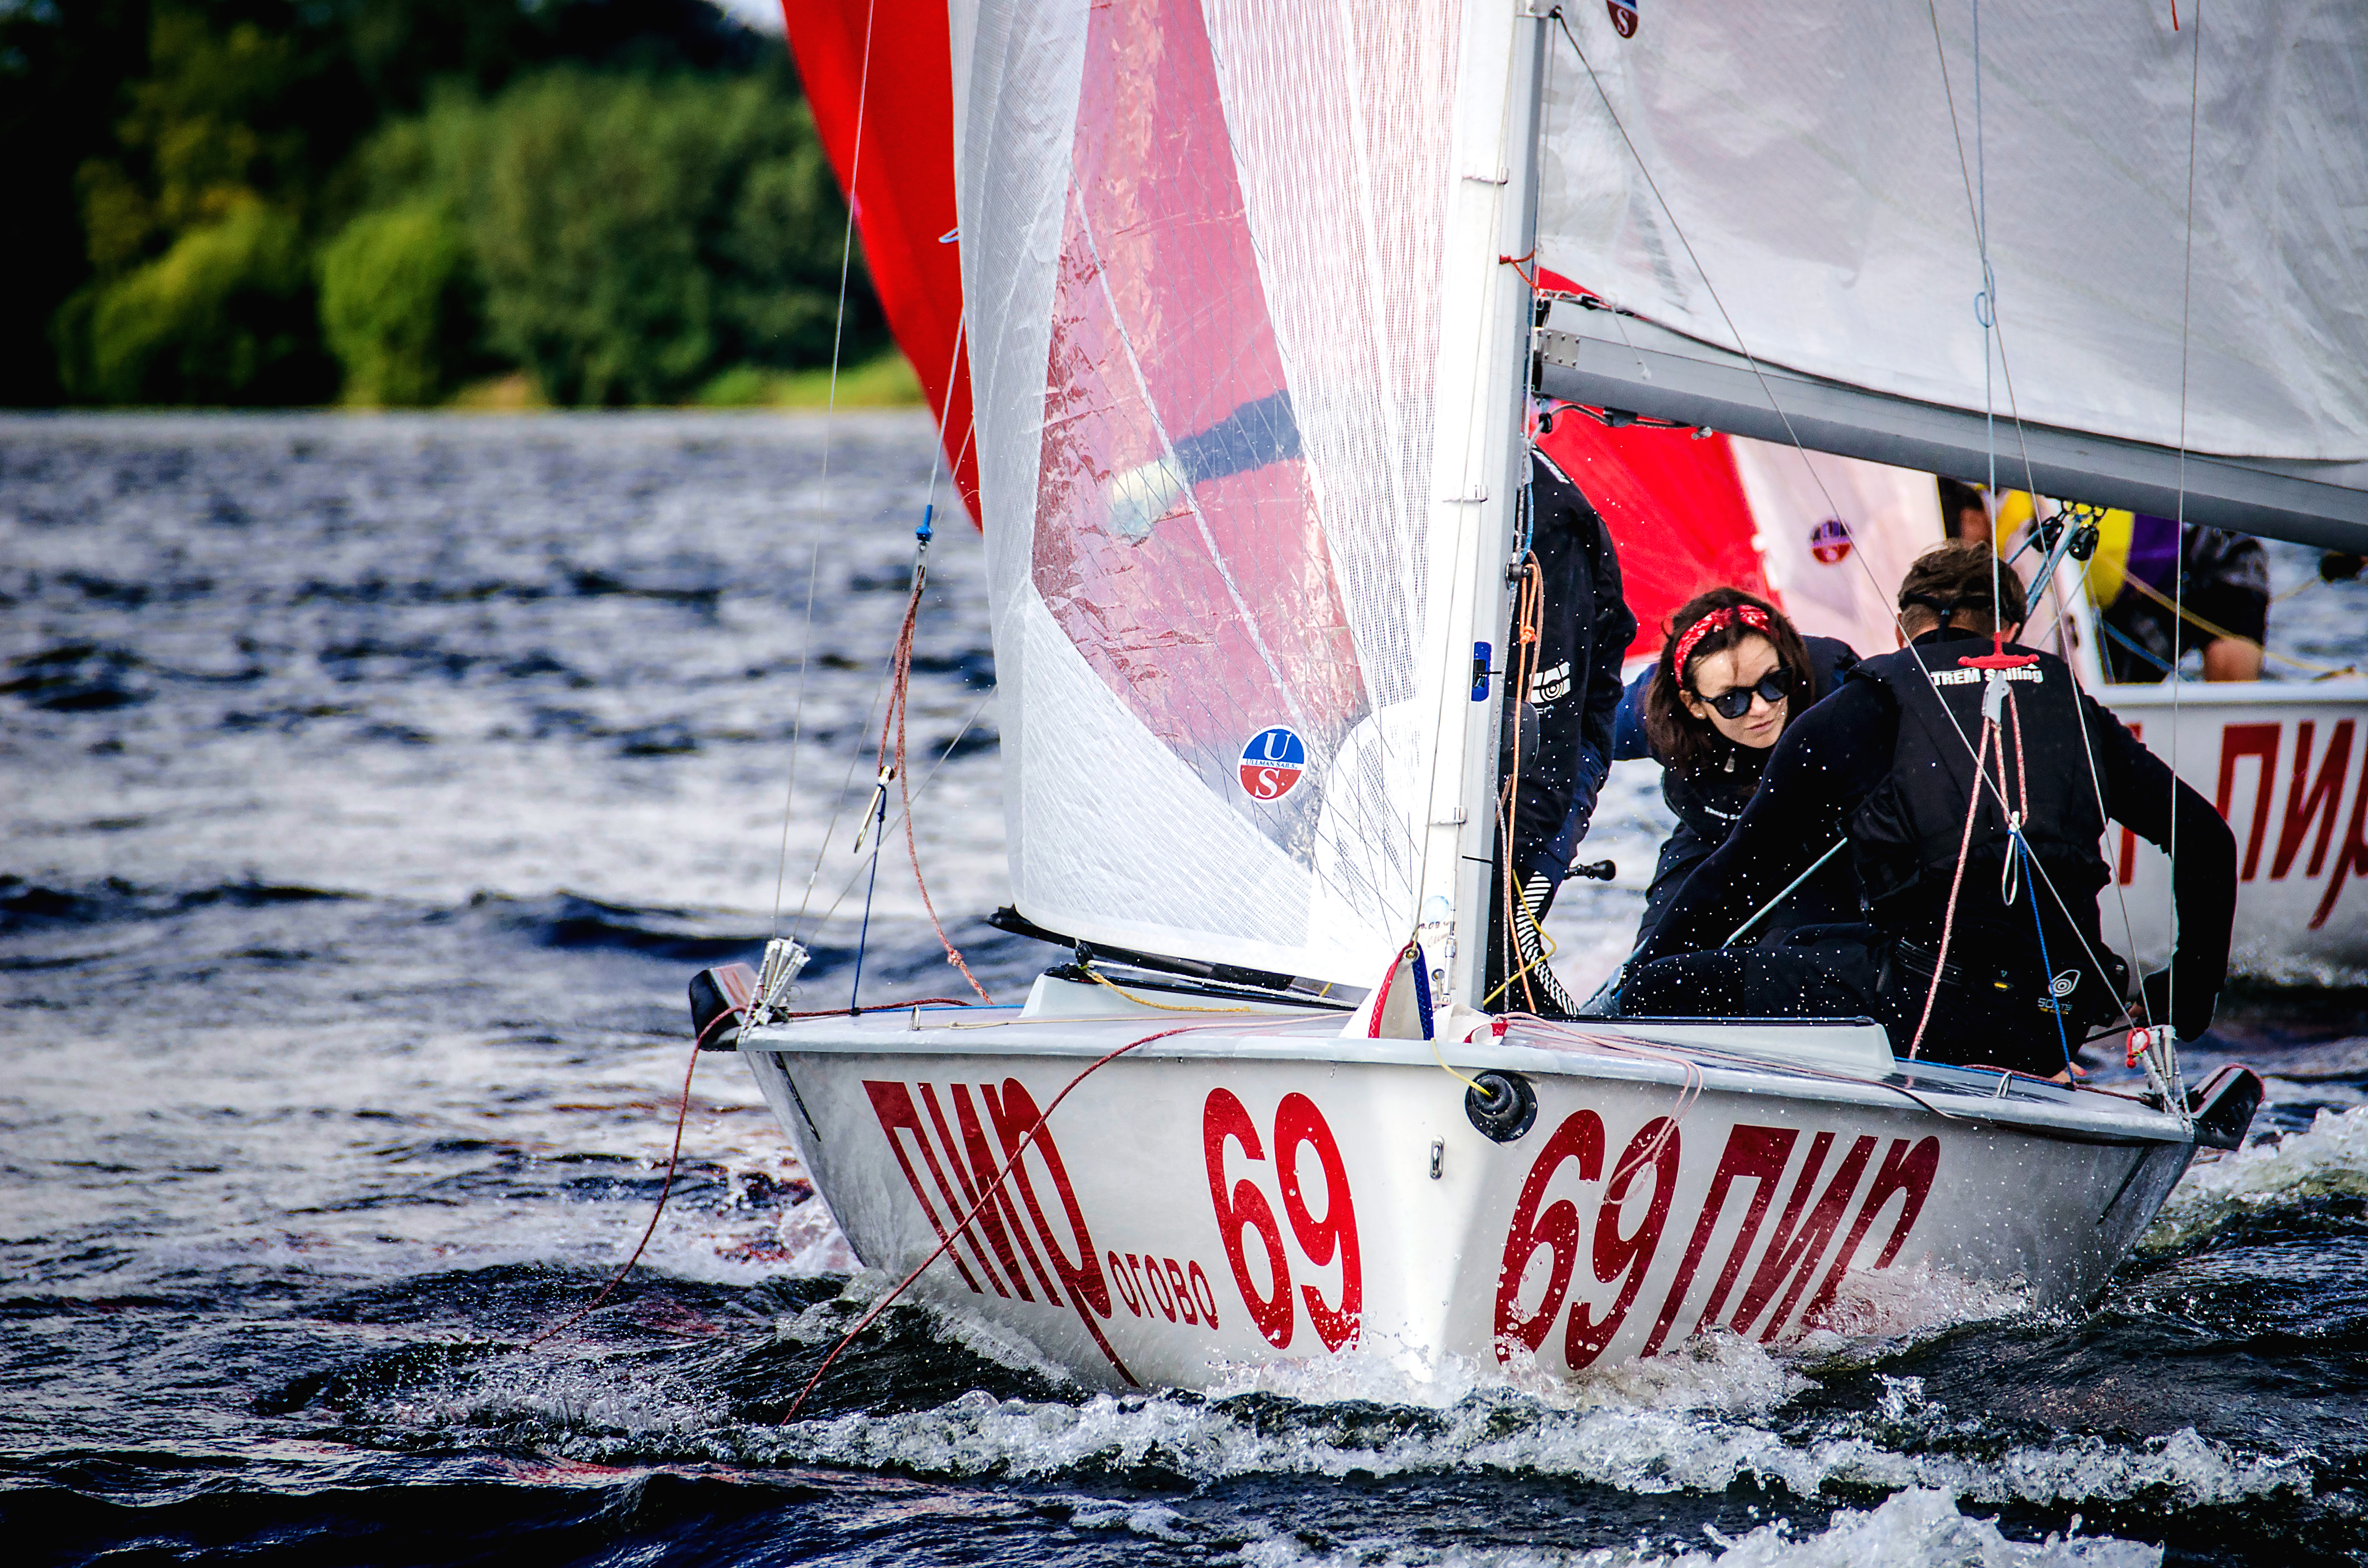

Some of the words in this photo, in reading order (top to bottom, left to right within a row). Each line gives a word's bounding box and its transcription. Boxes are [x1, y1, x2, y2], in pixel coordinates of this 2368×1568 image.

[1617, 7, 1629, 35] S
[1930, 668, 1981, 686] TREM
[1984, 667, 2044, 684] Siling
[1264, 732, 1294, 760] U
[1246, 759, 1274, 767] ULLMAN
[1255, 768, 1280, 798] S
[1203, 1087, 1362, 1354] 69
[1494, 1109, 1681, 1371] 69
